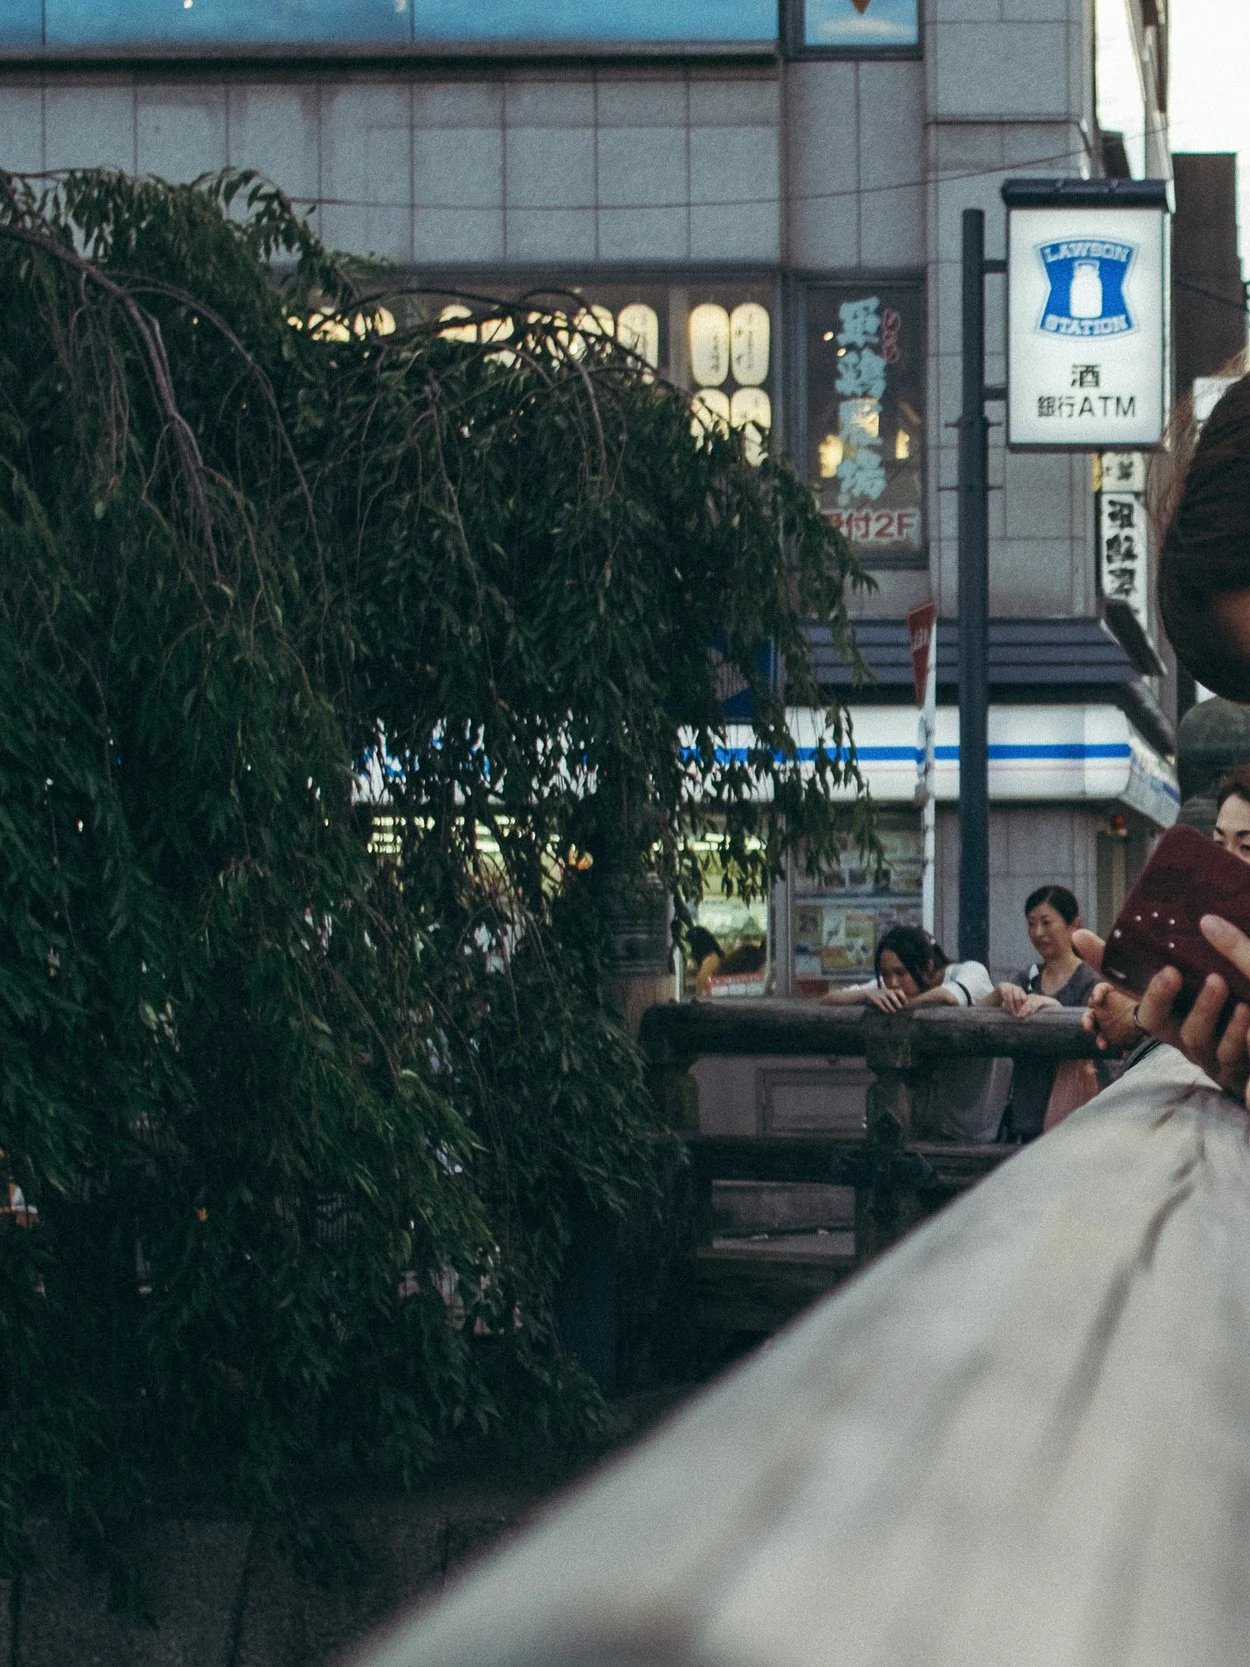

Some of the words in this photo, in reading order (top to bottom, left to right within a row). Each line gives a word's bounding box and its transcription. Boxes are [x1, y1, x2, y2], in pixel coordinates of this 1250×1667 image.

[1043, 242, 1131, 262] LAWSON
[1043, 315, 1129, 336] STATION
[1071, 364, 1101, 388] 酒
[1038, 395, 1136, 418] 銀行ATM
